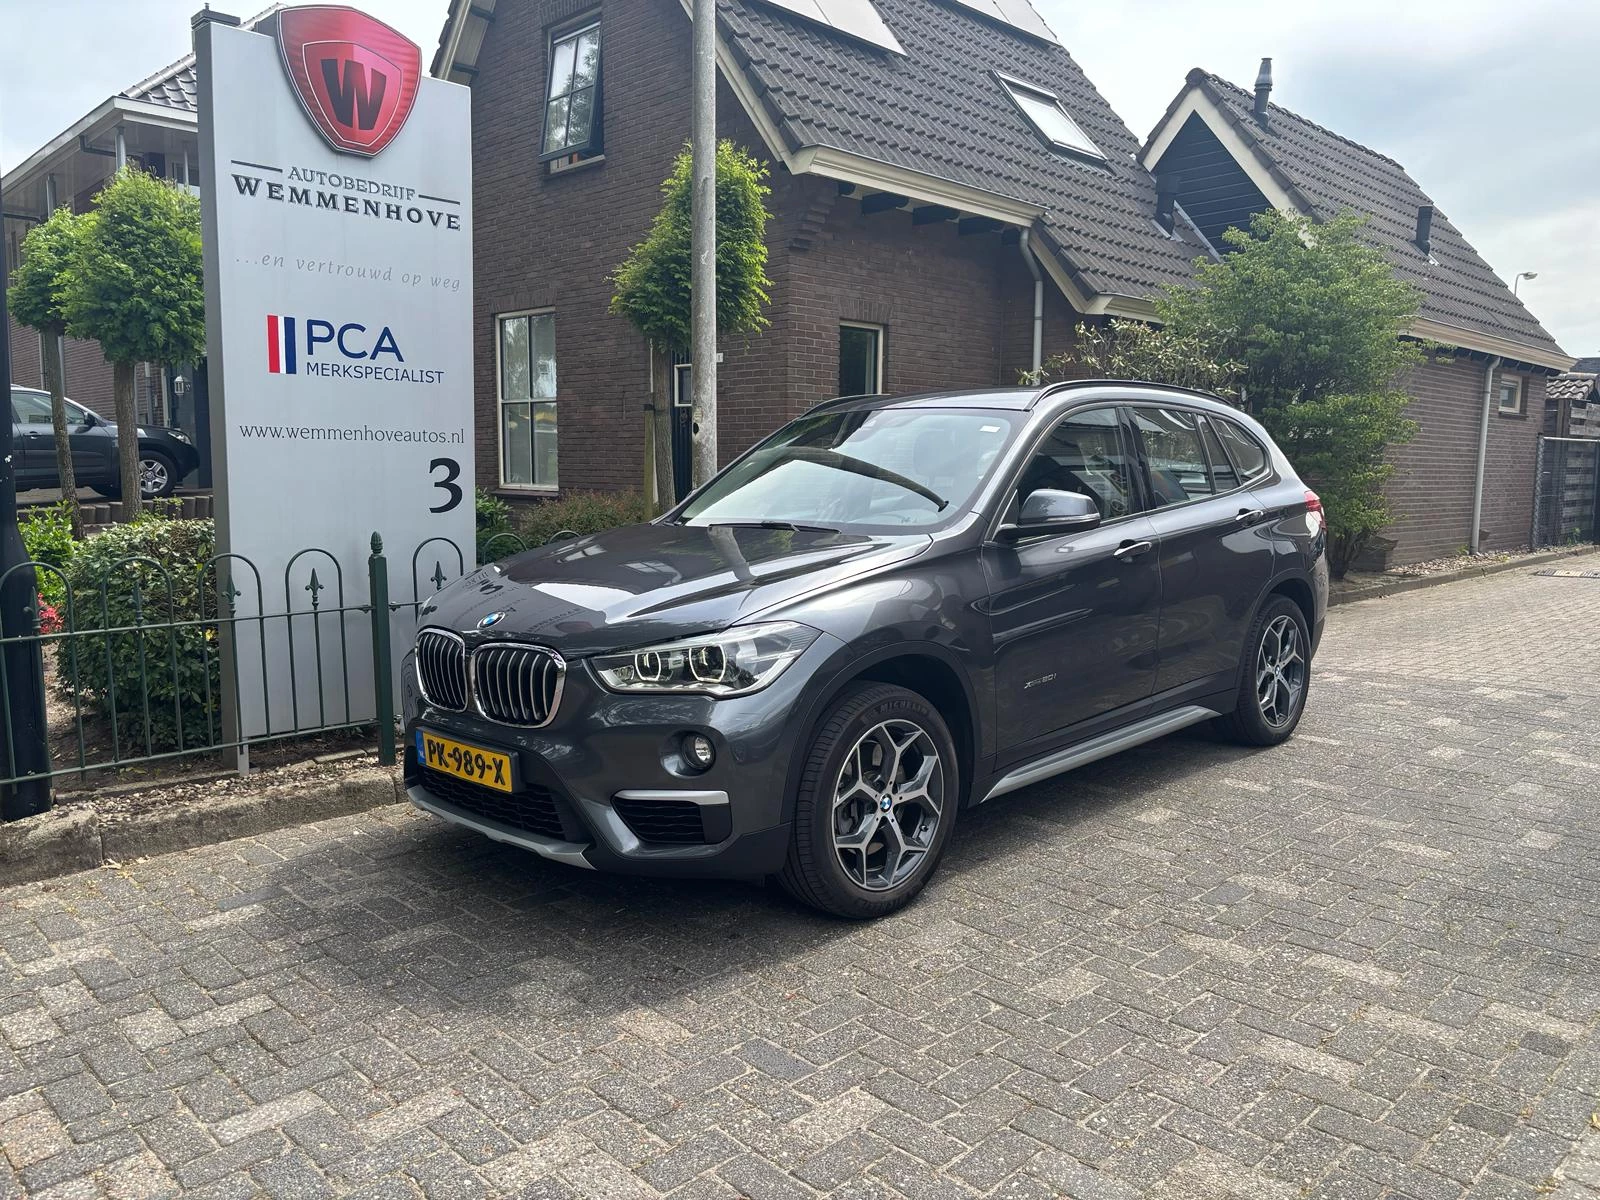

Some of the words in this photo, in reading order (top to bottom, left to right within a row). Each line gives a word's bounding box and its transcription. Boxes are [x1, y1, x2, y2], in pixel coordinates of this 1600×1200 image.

[320, 58, 387, 131] W
[231, 173, 461, 231] WEMMENHOVE
[287, 166, 416, 201] AUTOBEDRIJF
[296, 258, 392, 281] vertrouwd
[401, 273, 422, 287] op
[430, 276, 460, 292] weg
[306, 319, 404, 363] PCA
[306, 362, 445, 384] MERKSPECIALIST
[239, 424, 465, 444] www.wemmenhoveautos.nl
[428, 457, 463, 514] 3
[427, 738, 506, 786] PK-989-X
